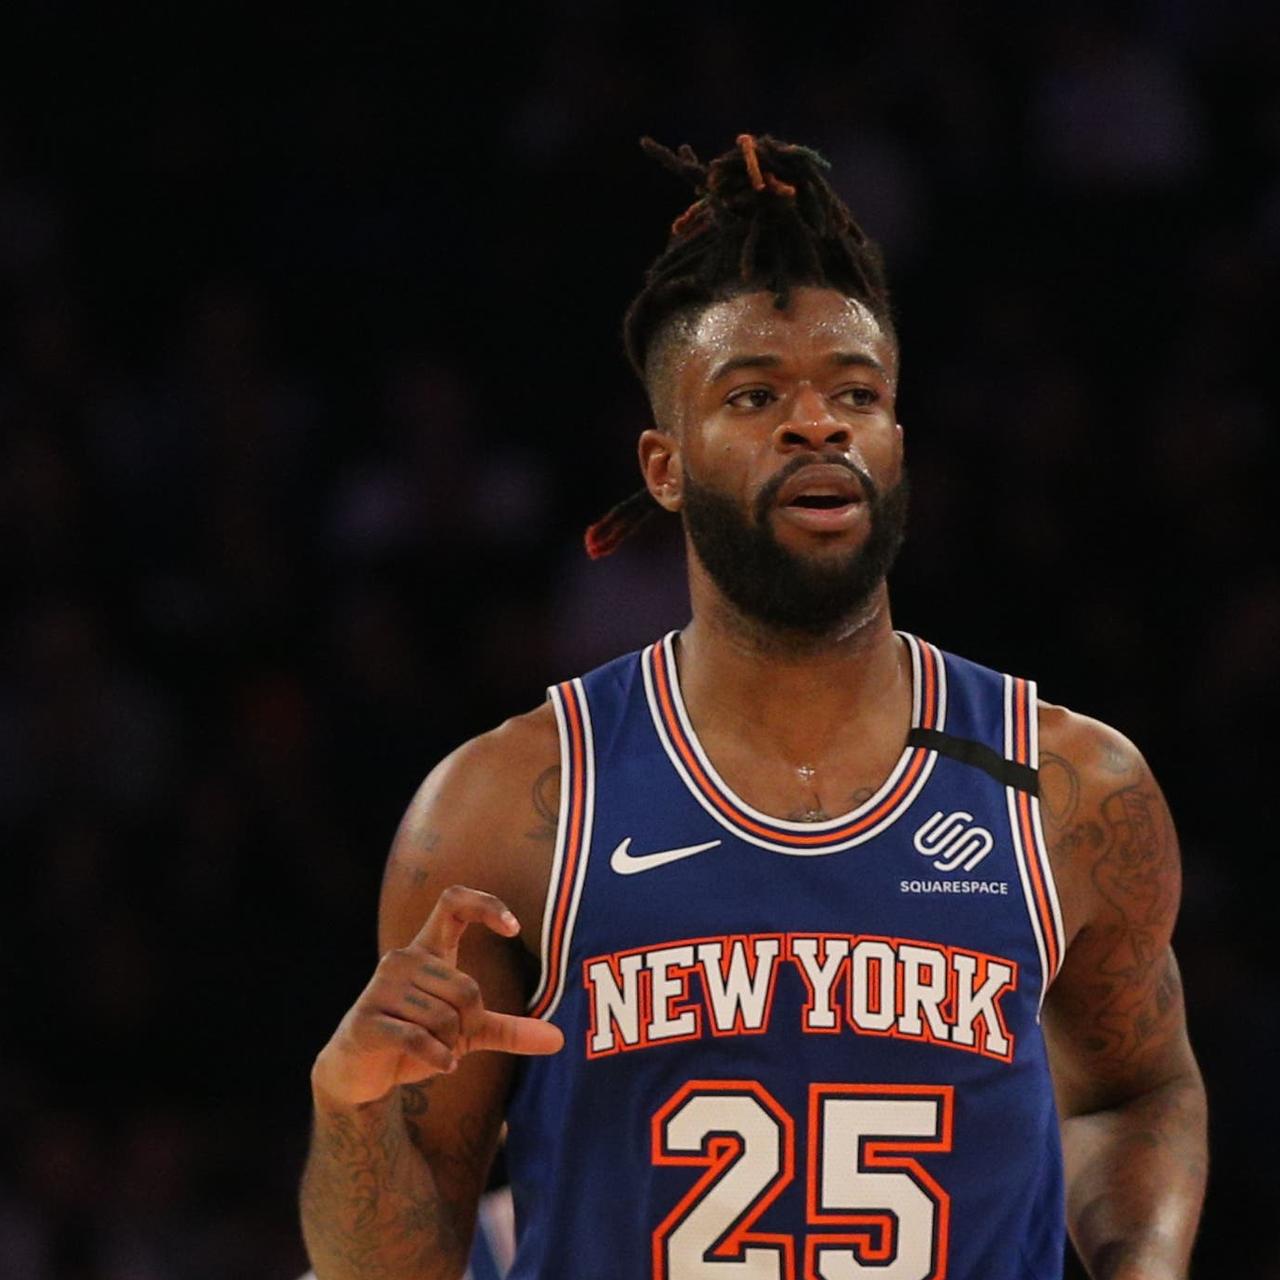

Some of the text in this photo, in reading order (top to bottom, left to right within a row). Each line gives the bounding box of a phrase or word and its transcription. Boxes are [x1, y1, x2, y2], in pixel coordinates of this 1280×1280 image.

[900, 880, 1008, 895] SQUARESPACE
[584, 932, 1018, 1063] NEW YORK
